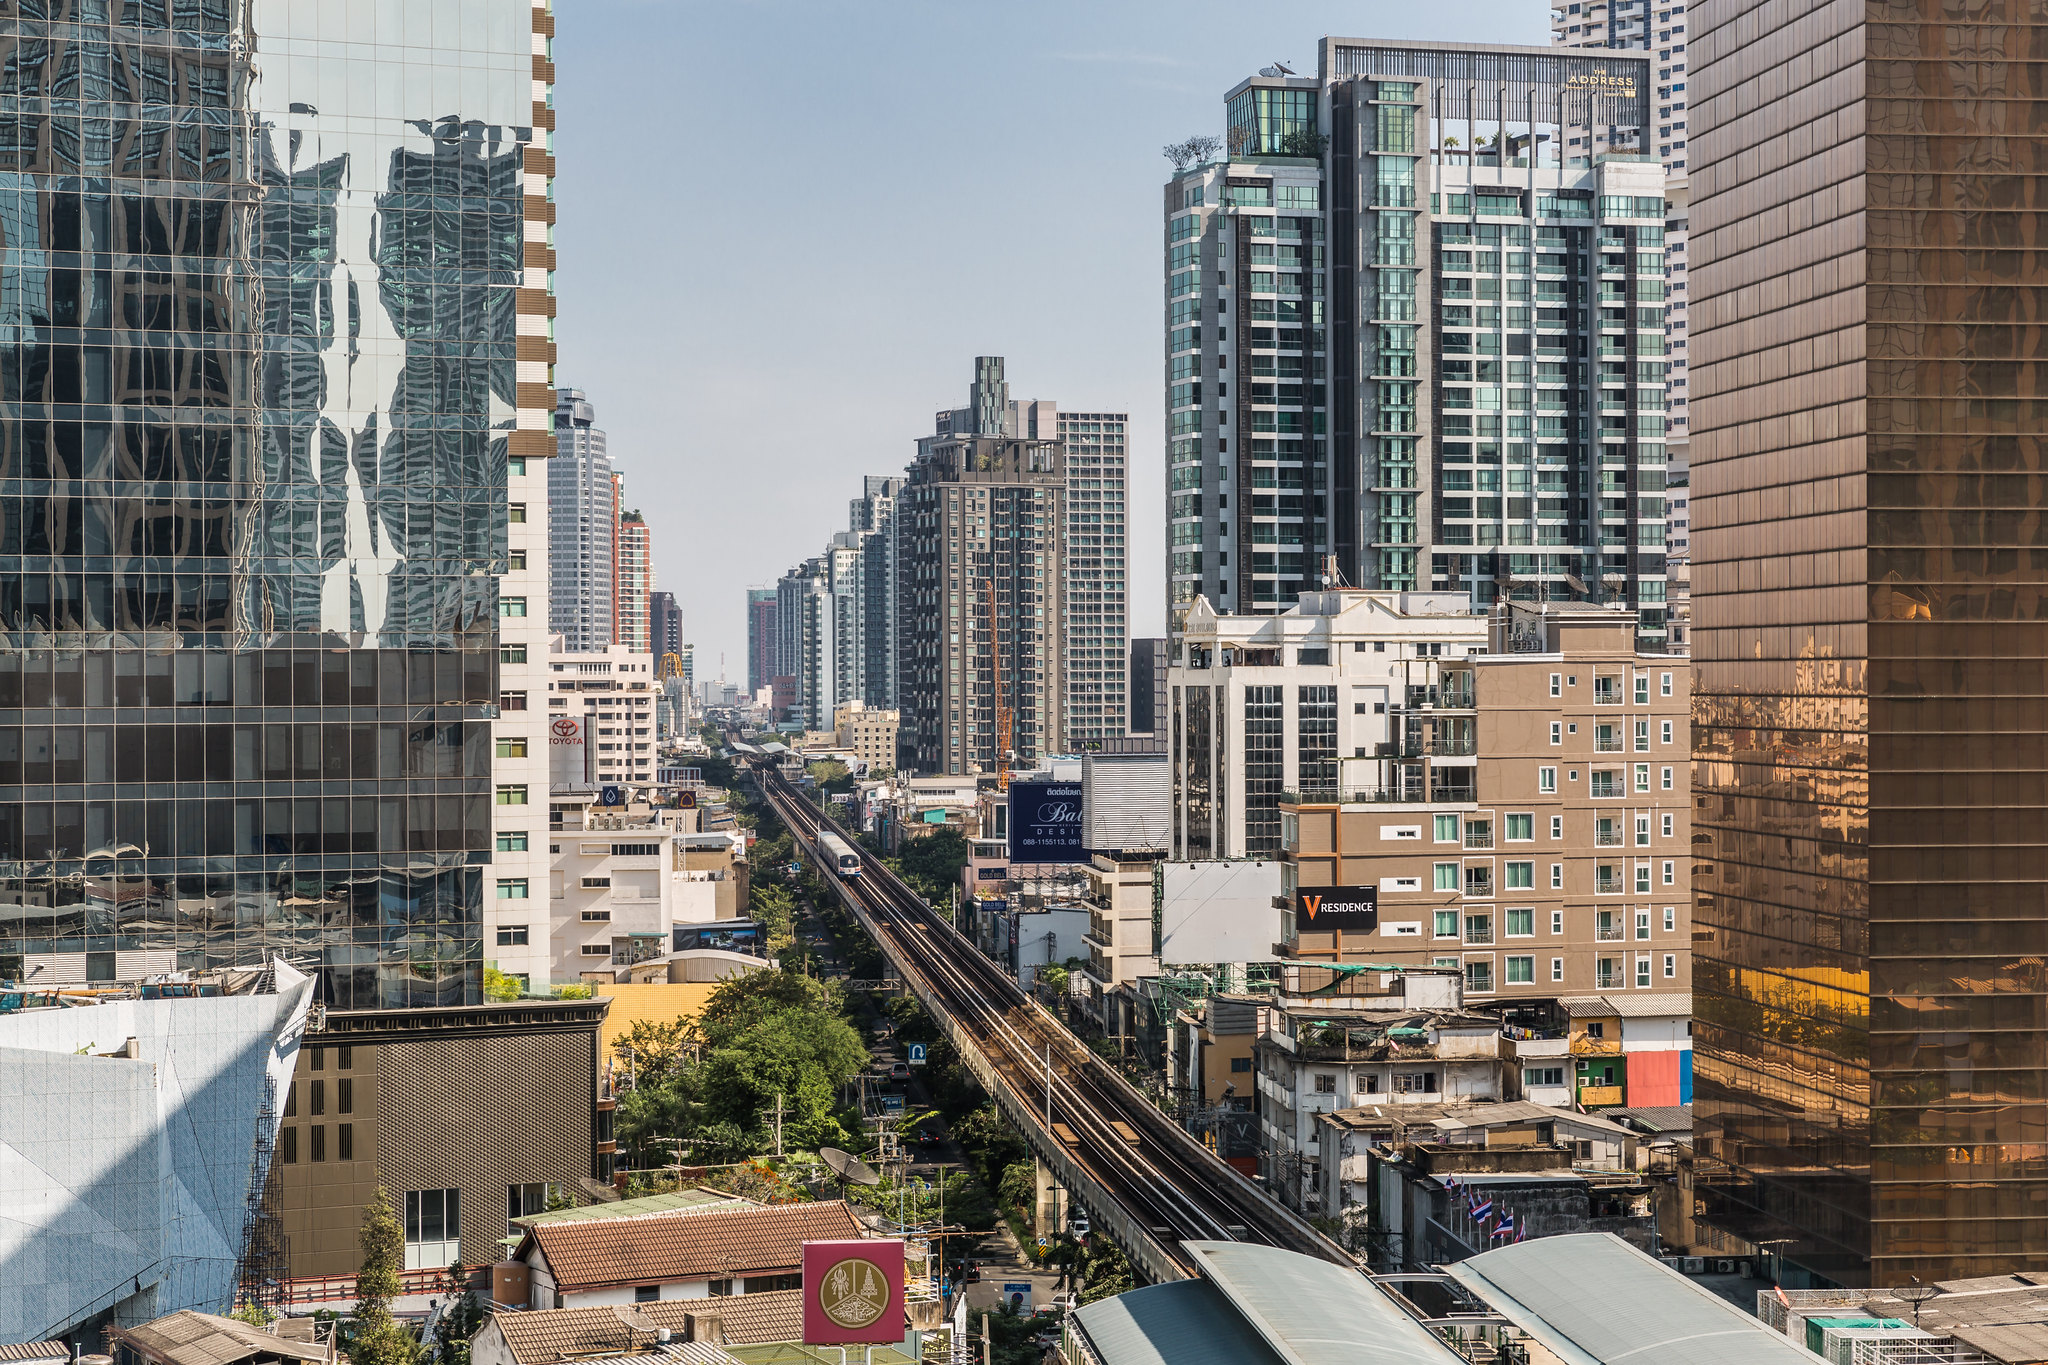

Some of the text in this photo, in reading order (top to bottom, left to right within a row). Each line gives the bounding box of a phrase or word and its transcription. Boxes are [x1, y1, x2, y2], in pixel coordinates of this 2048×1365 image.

[1568, 76, 1634, 86] ADDRESS
[549, 737, 583, 745] TOYOTA
[1321, 903, 1373, 912] RESIDENCE
